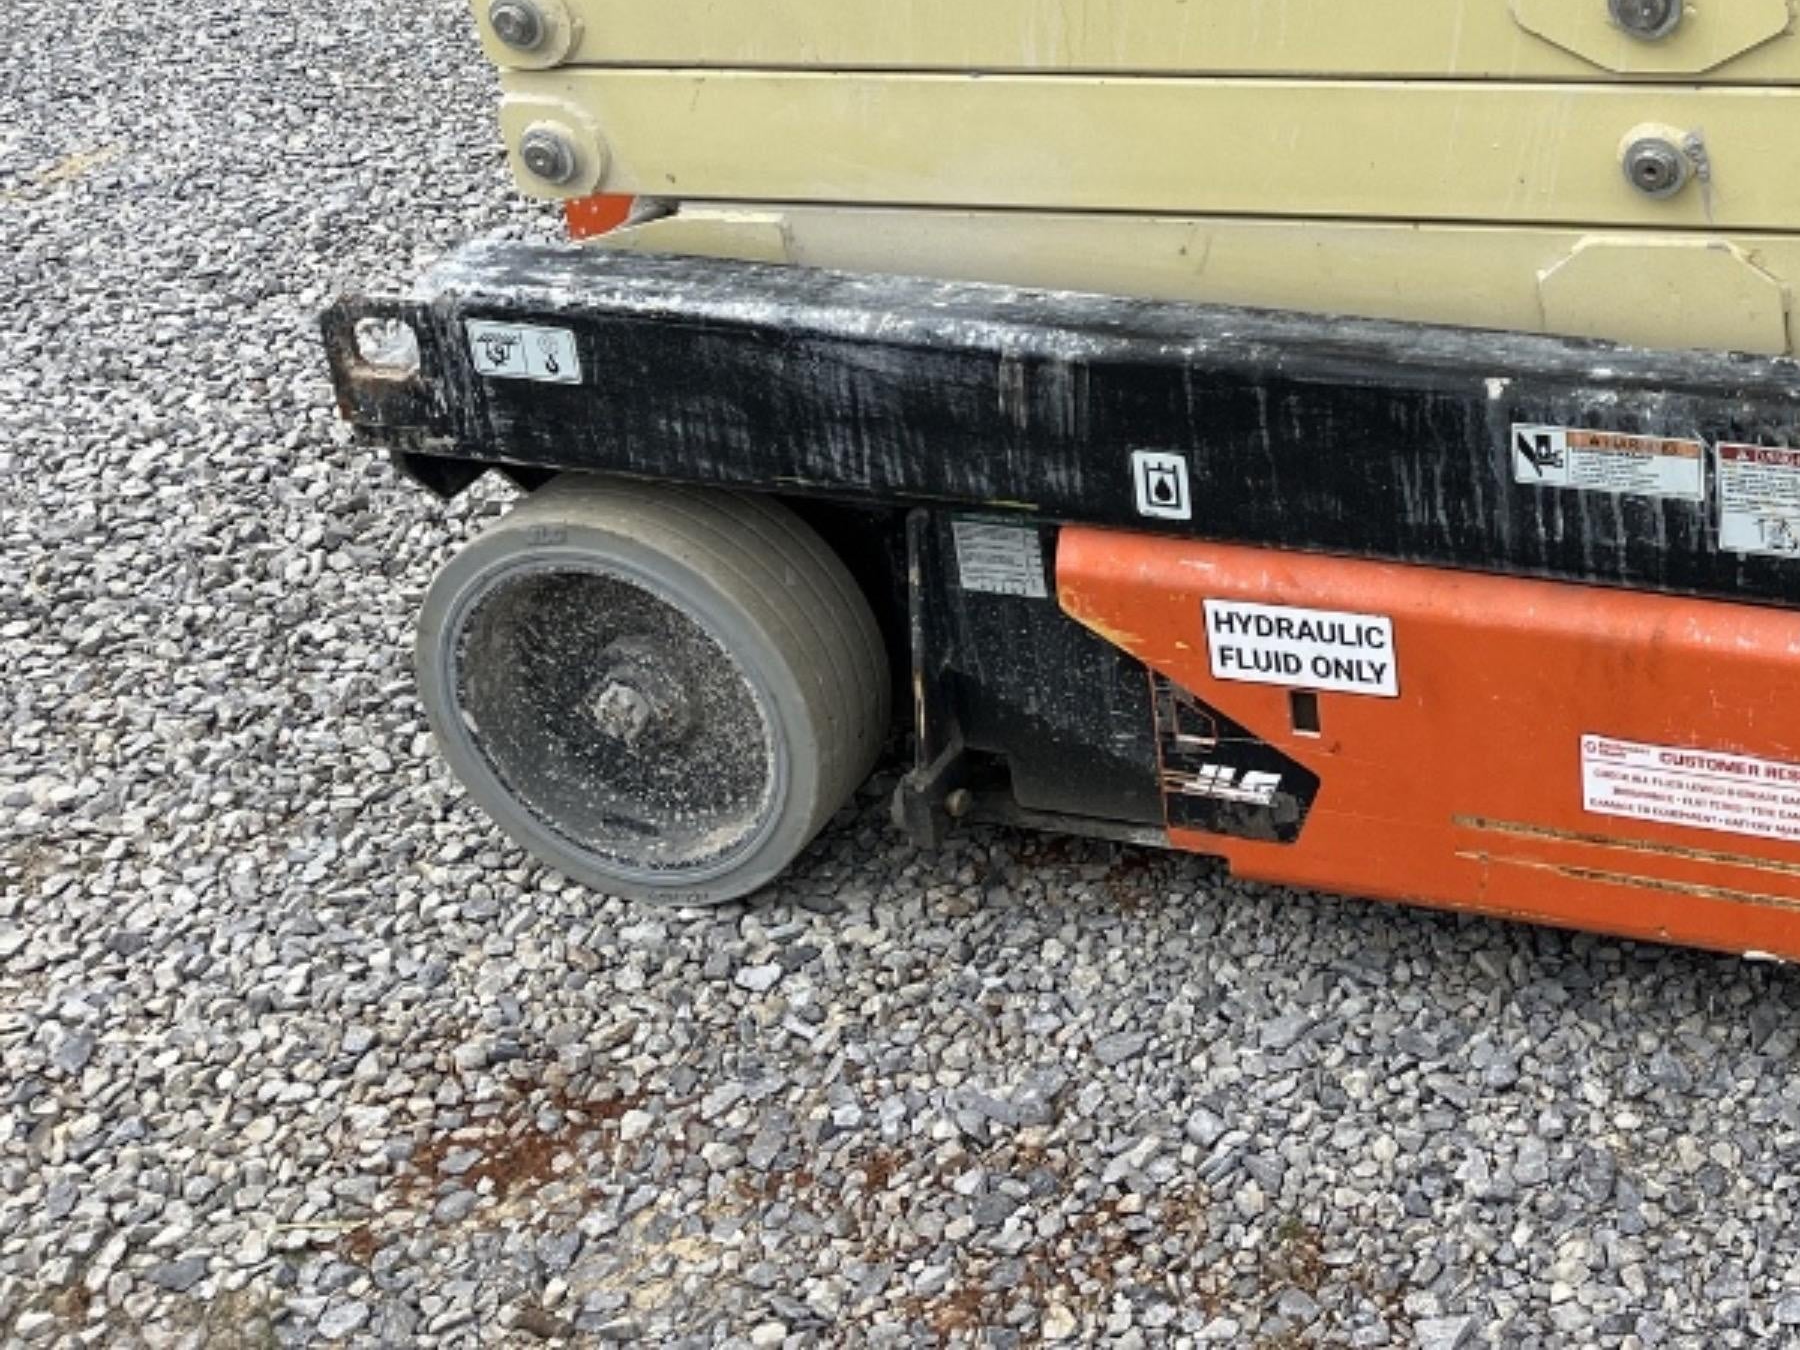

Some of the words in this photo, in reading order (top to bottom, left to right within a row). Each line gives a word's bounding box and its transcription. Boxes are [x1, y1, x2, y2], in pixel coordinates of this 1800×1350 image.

[1214, 610, 1386, 650] HYDRAULIC
[1218, 645, 1303, 676] FLUID
[1311, 656, 1387, 686] ONLY
[1658, 751, 1760, 778] CUSTOMER
